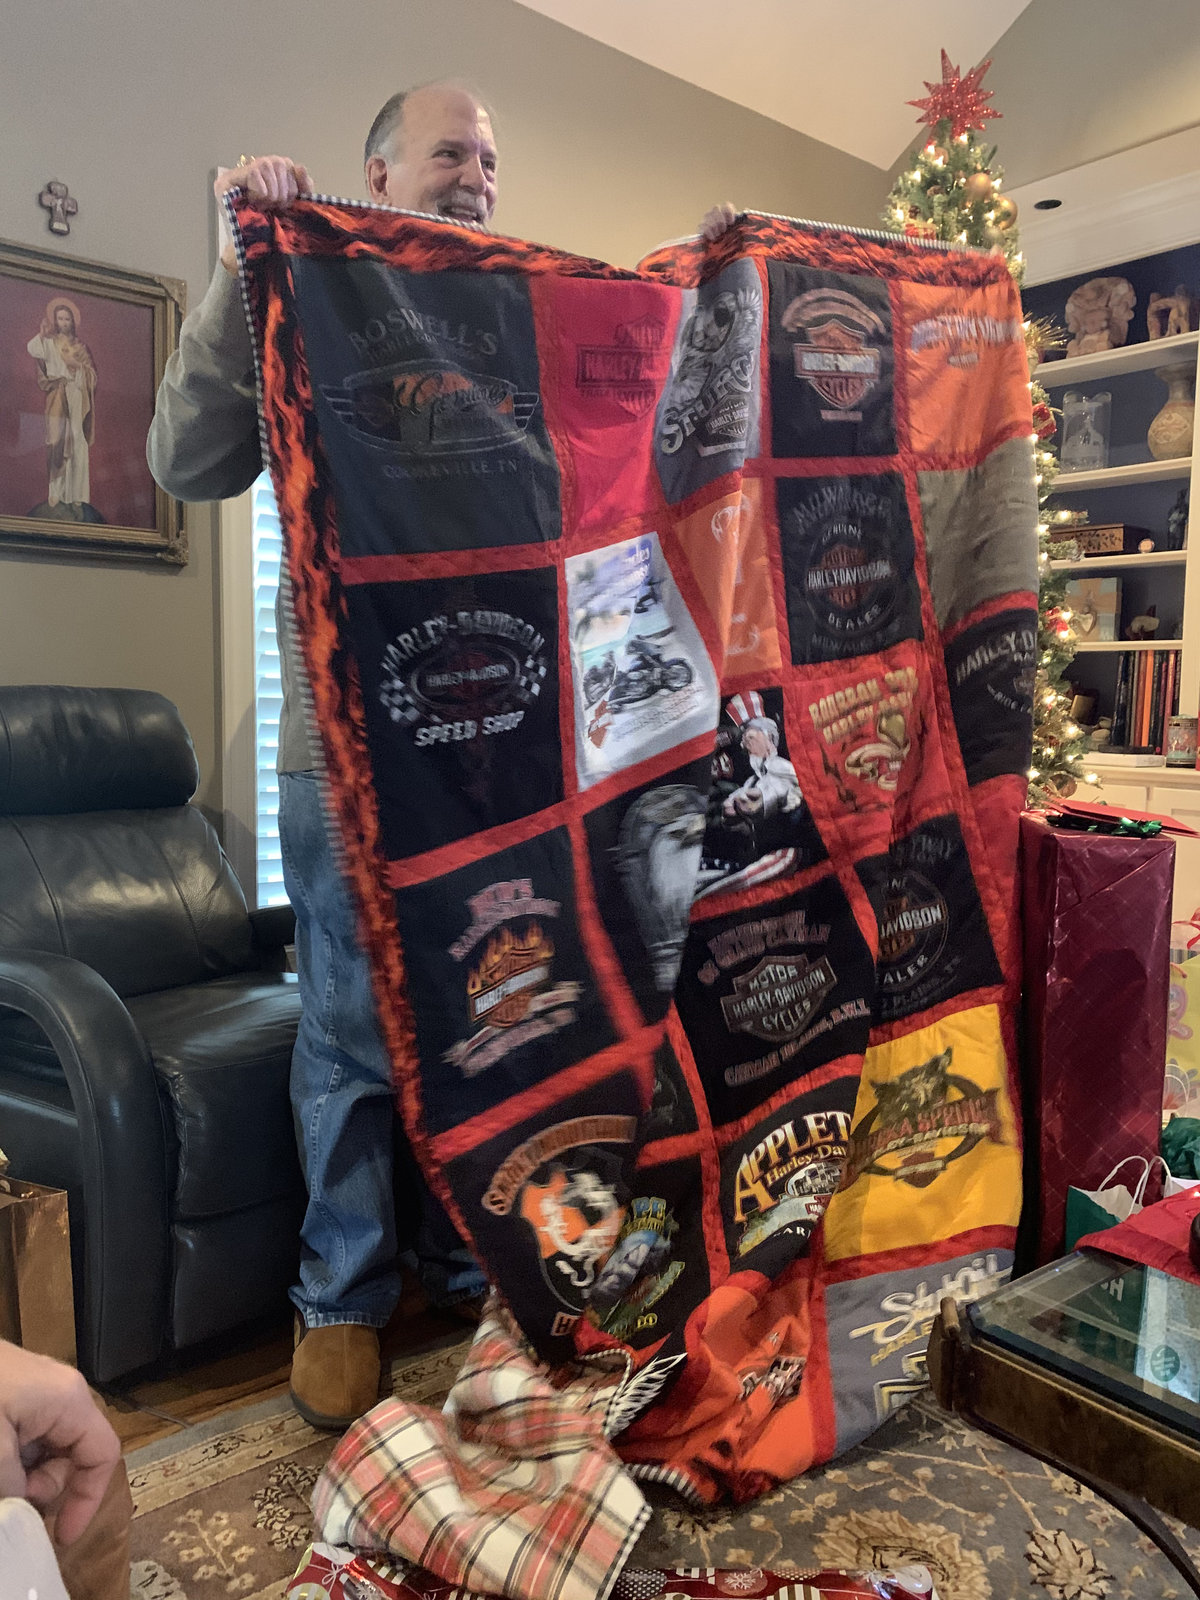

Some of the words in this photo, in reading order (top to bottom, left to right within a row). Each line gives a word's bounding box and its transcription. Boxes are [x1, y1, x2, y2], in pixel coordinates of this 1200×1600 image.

[732, 968, 826, 1018] HARLEY-DAVIDSON
[750, 964, 799, 992] MOTOR
[762, 1000, 812, 1033] CYCLES
